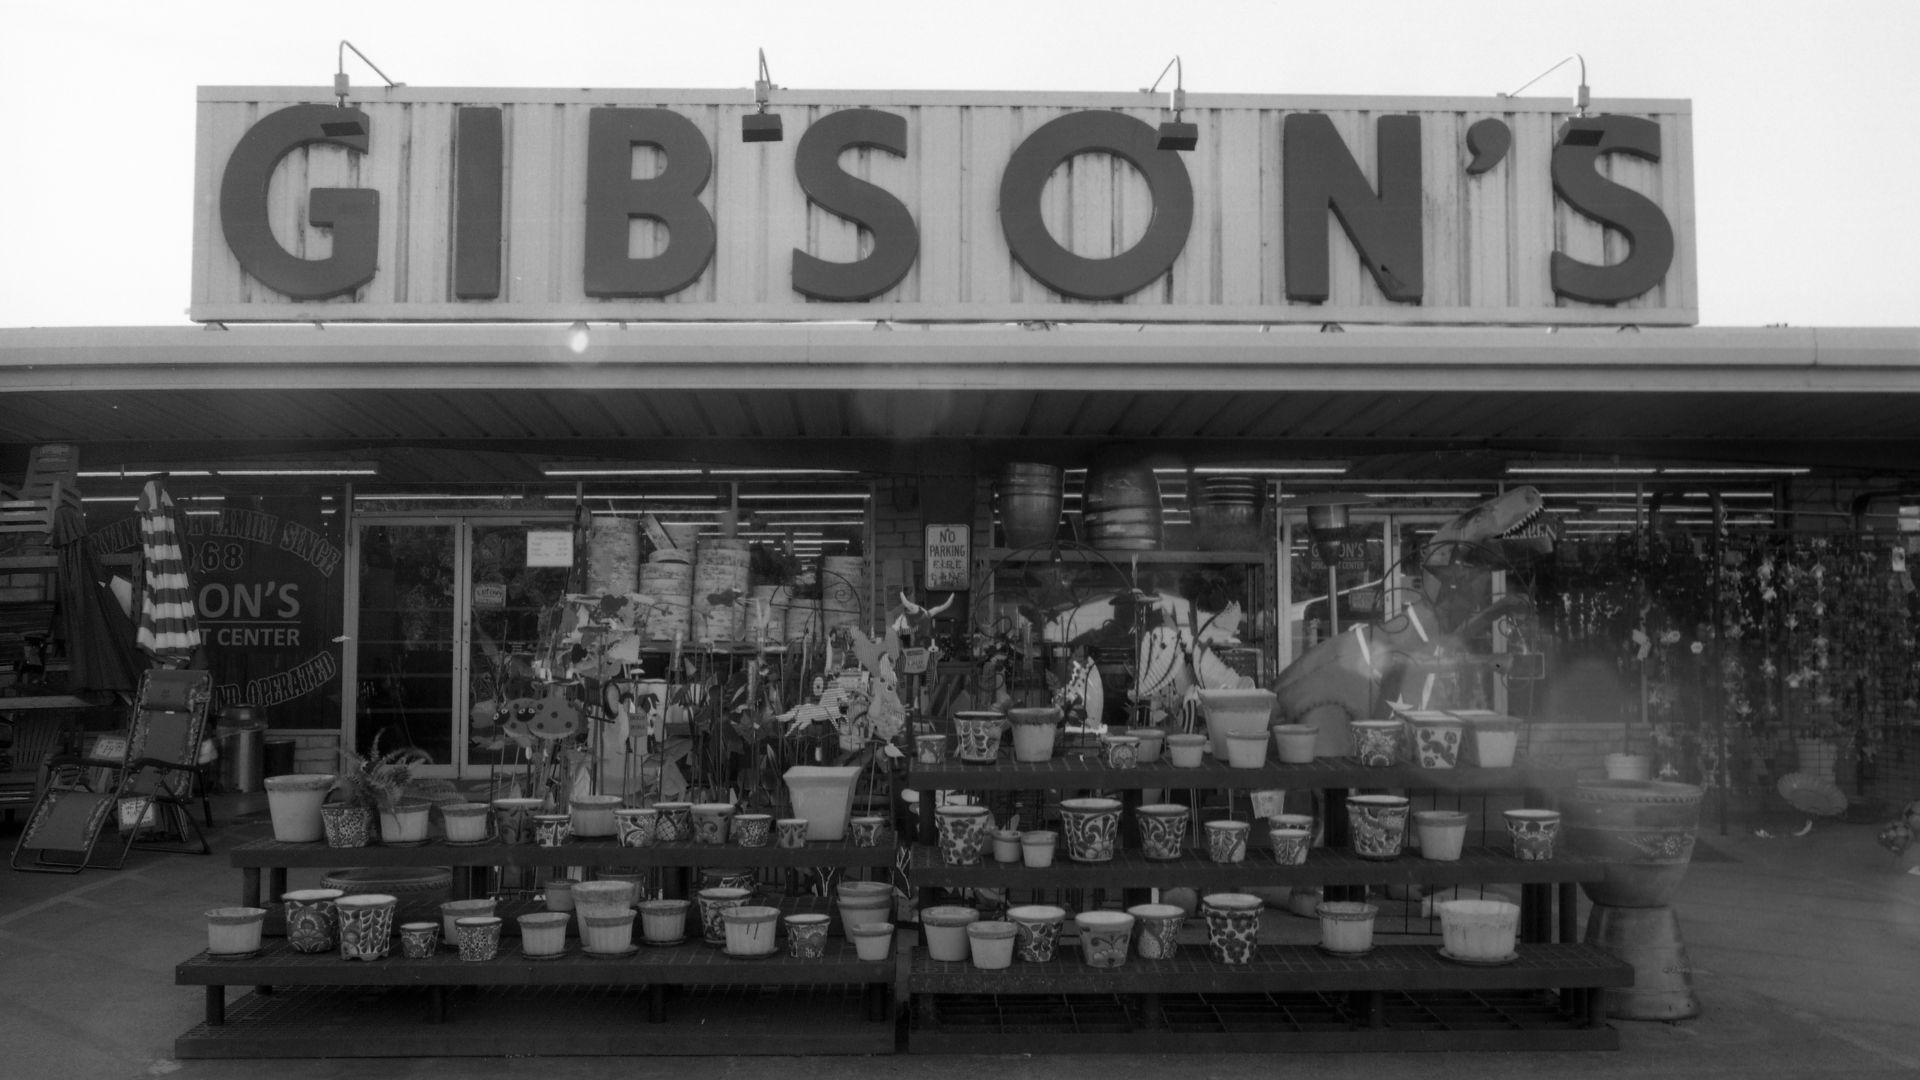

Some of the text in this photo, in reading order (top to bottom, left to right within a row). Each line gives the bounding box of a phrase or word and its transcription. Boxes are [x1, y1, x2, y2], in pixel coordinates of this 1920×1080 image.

[220, 103, 1675, 303] GIBSON'S
[280, 520, 342, 578] SINCE
[929, 545, 965, 558] PARKING
[939, 531, 956, 543] NO
[198, 580, 301, 619] ON'S
[217, 627, 300, 647] CENTER
[246, 650, 337, 708] OPERATED
